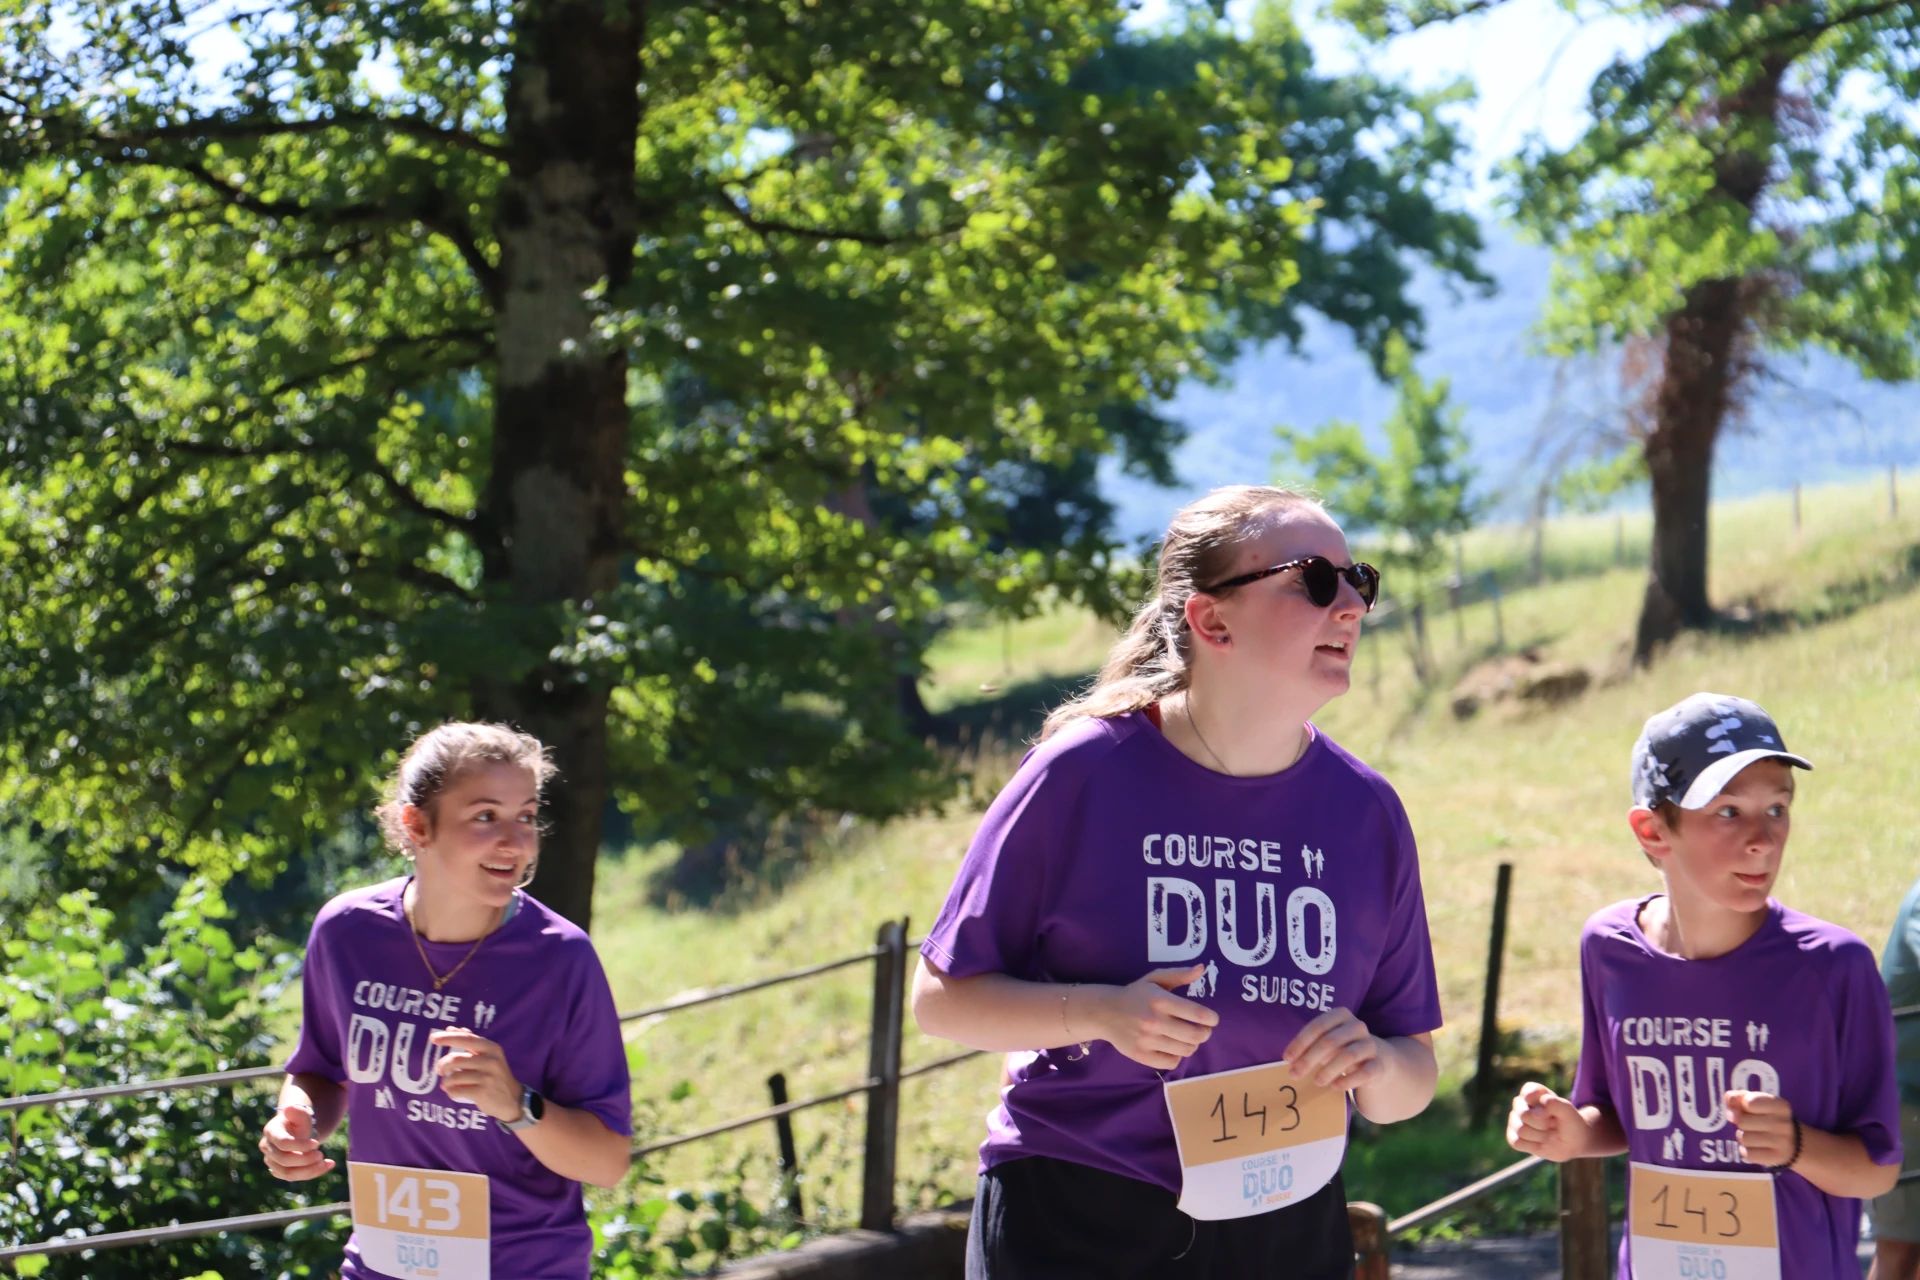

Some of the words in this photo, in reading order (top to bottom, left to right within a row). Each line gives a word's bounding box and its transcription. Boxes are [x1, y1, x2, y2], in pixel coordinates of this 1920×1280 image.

[1143, 834, 1282, 873] COURSE
[1147, 877, 1337, 975] DUO
[353, 980, 462, 1022] COURSE
[1241, 974, 1336, 1012] SUISSE
[1622, 1017, 1732, 1048] COURSE
[347, 1013, 476, 1104] DU
[406, 1099, 489, 1131] SUISSE
[1210, 1085, 1301, 1143] 143
[1241, 1155, 1278, 1171] COURSE
[1243, 1165, 1293, 1199] DUO
[374, 1173, 461, 1231] 143
[1652, 1185, 1741, 1237] 143
[397, 1244, 439, 1268] DUO
